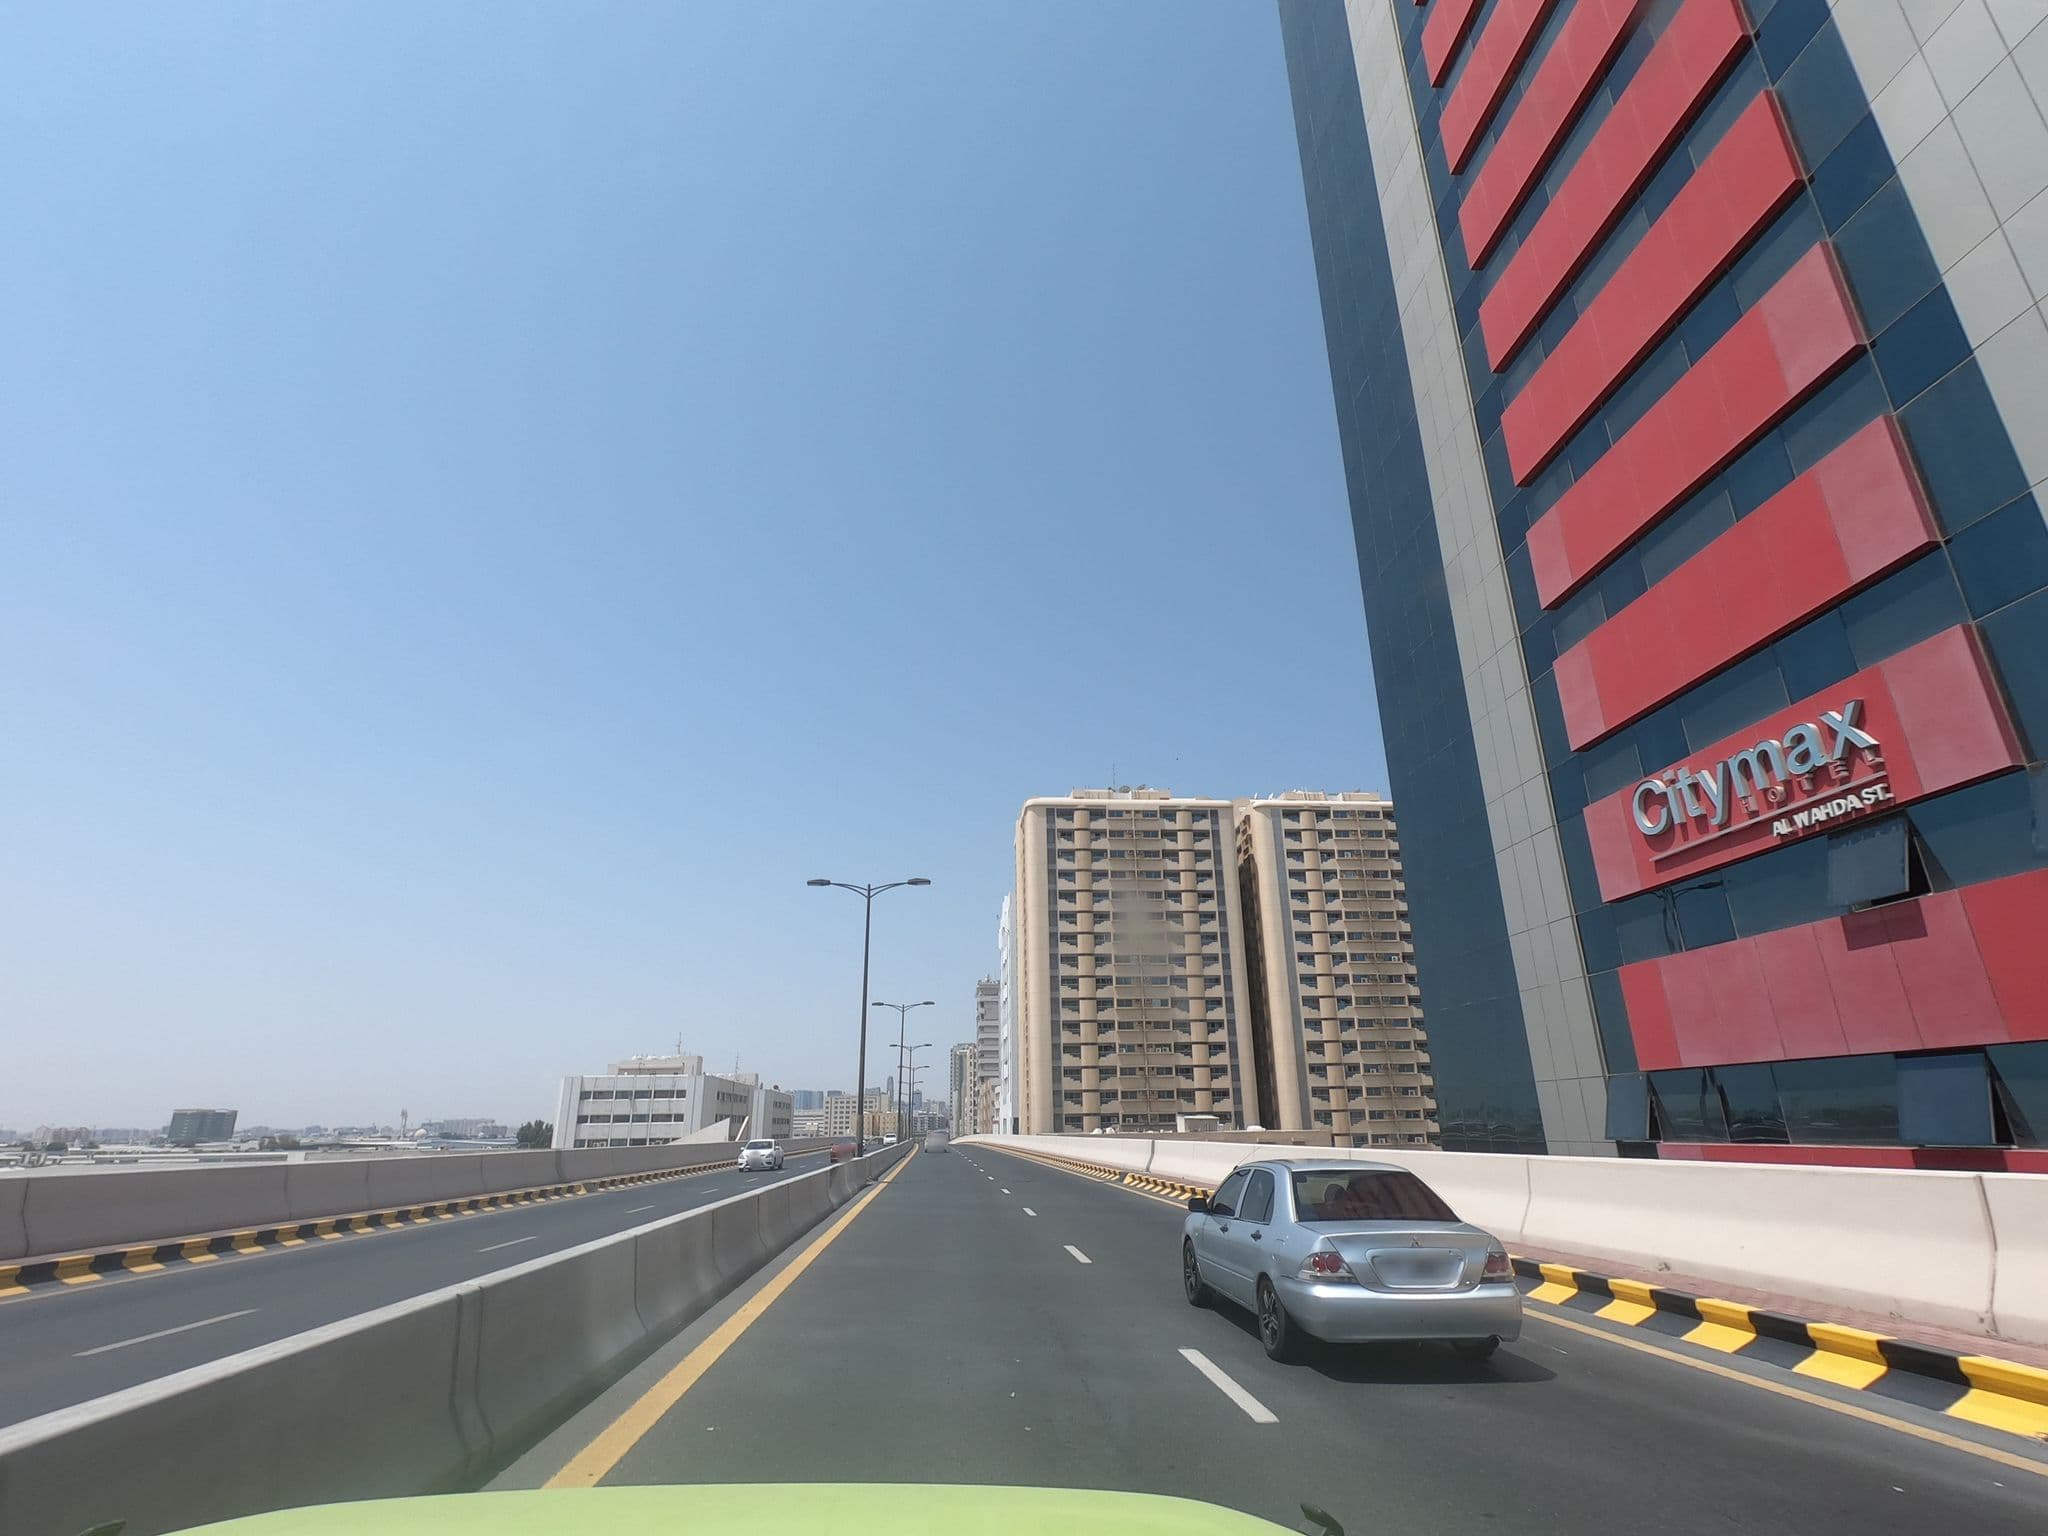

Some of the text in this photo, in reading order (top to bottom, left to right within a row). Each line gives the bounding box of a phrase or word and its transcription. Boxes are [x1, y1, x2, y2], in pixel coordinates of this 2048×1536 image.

[1632, 698, 1880, 836] Citymax
[1772, 783, 1895, 837] AL WAHDA ST.
